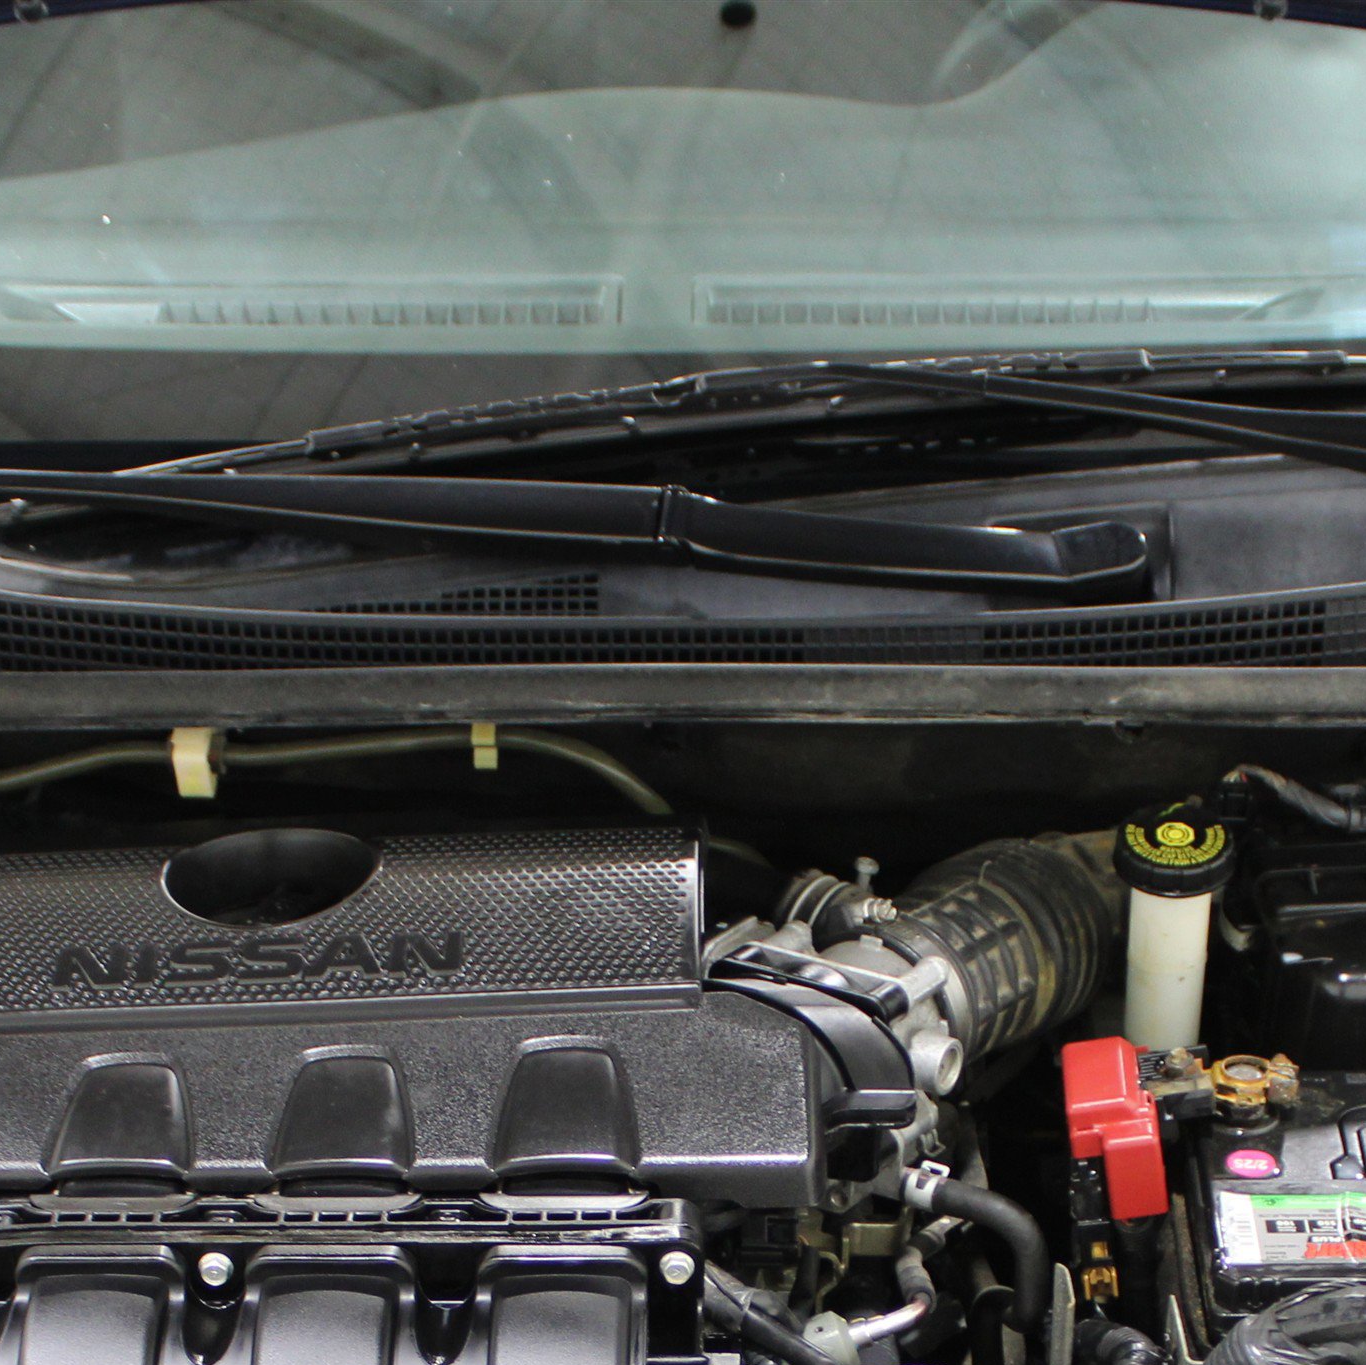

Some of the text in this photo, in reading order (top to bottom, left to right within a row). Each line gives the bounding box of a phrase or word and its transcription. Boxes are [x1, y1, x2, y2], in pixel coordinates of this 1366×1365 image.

[51, 931, 466, 992] NISSAN
[1233, 1158, 1269, 1171] 2/25
[1311, 1235, 1342, 1243] PLUS
